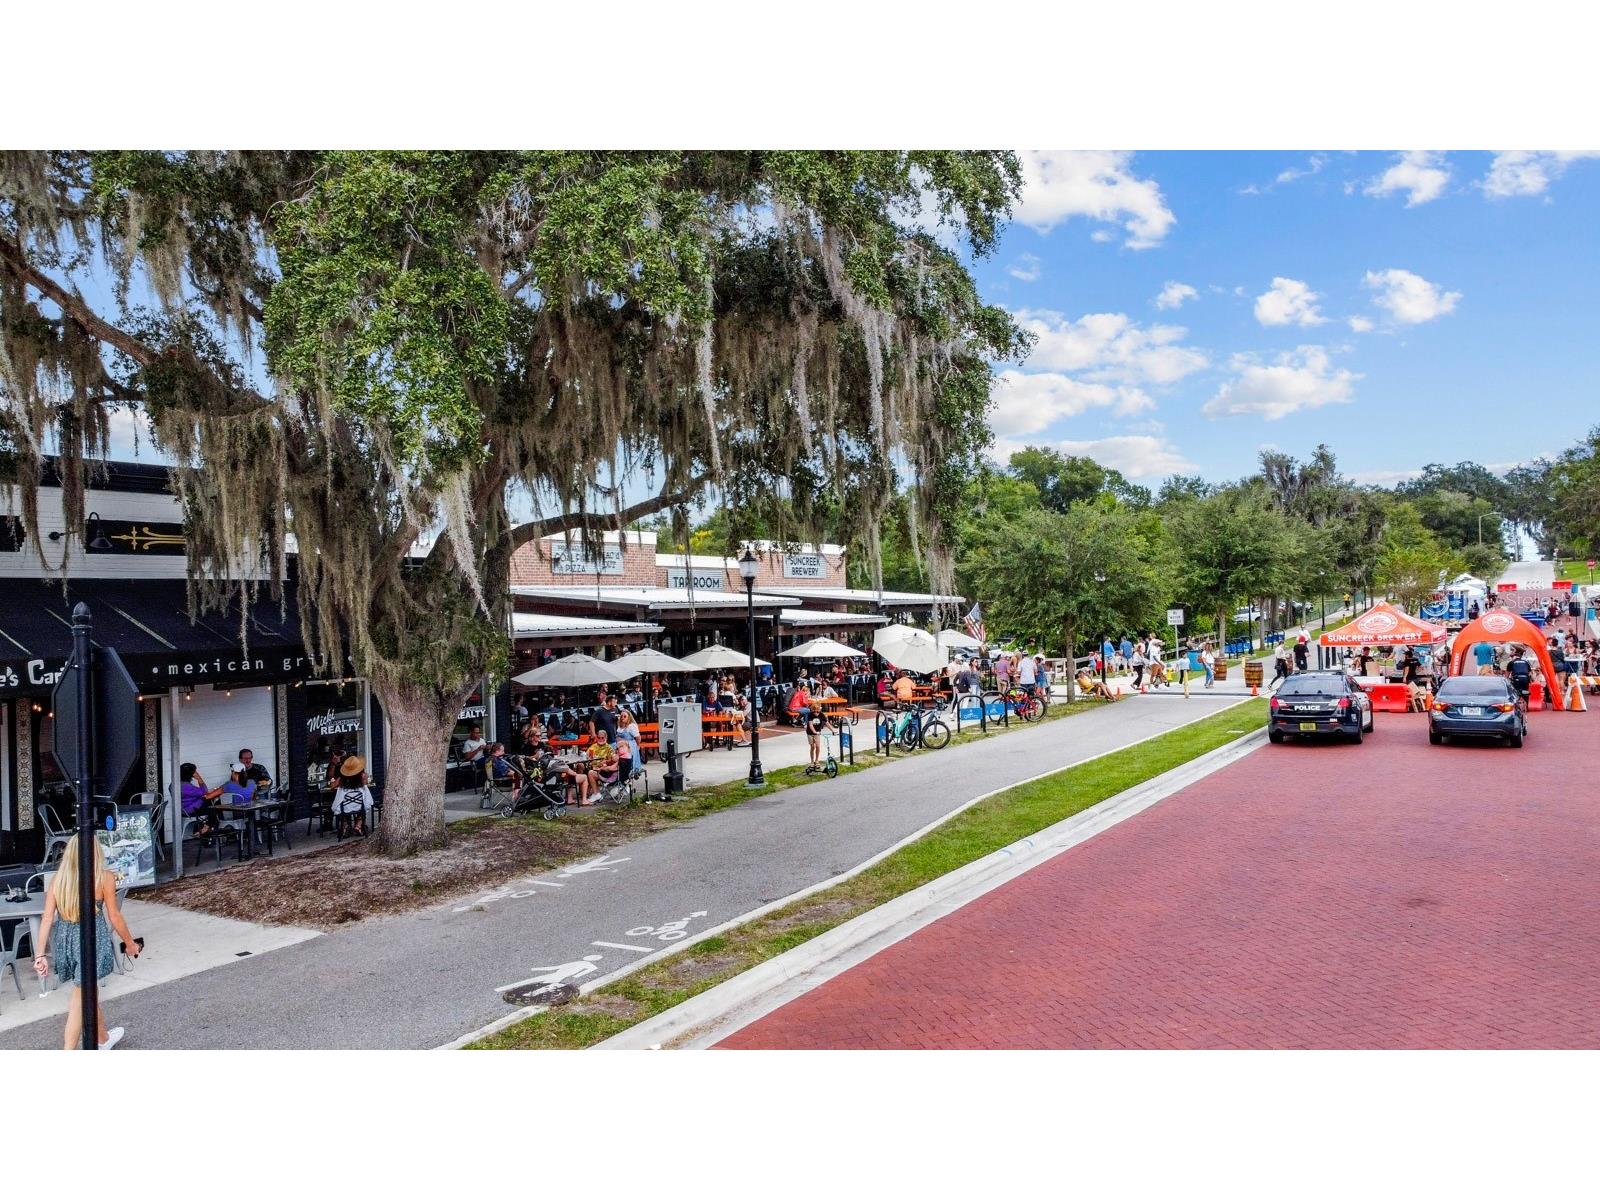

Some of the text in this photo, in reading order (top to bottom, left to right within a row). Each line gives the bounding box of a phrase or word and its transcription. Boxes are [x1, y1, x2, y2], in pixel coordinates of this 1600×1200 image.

[789, 556, 820, 566] SUNCREEK
[791, 567, 819, 576] BREWERY
[693, 577, 720, 588] ROOM
[1328, 634, 1374, 642] SUNCREEK
[168, 658, 264, 675] mexican
[320, 722, 360, 736] REALTY
